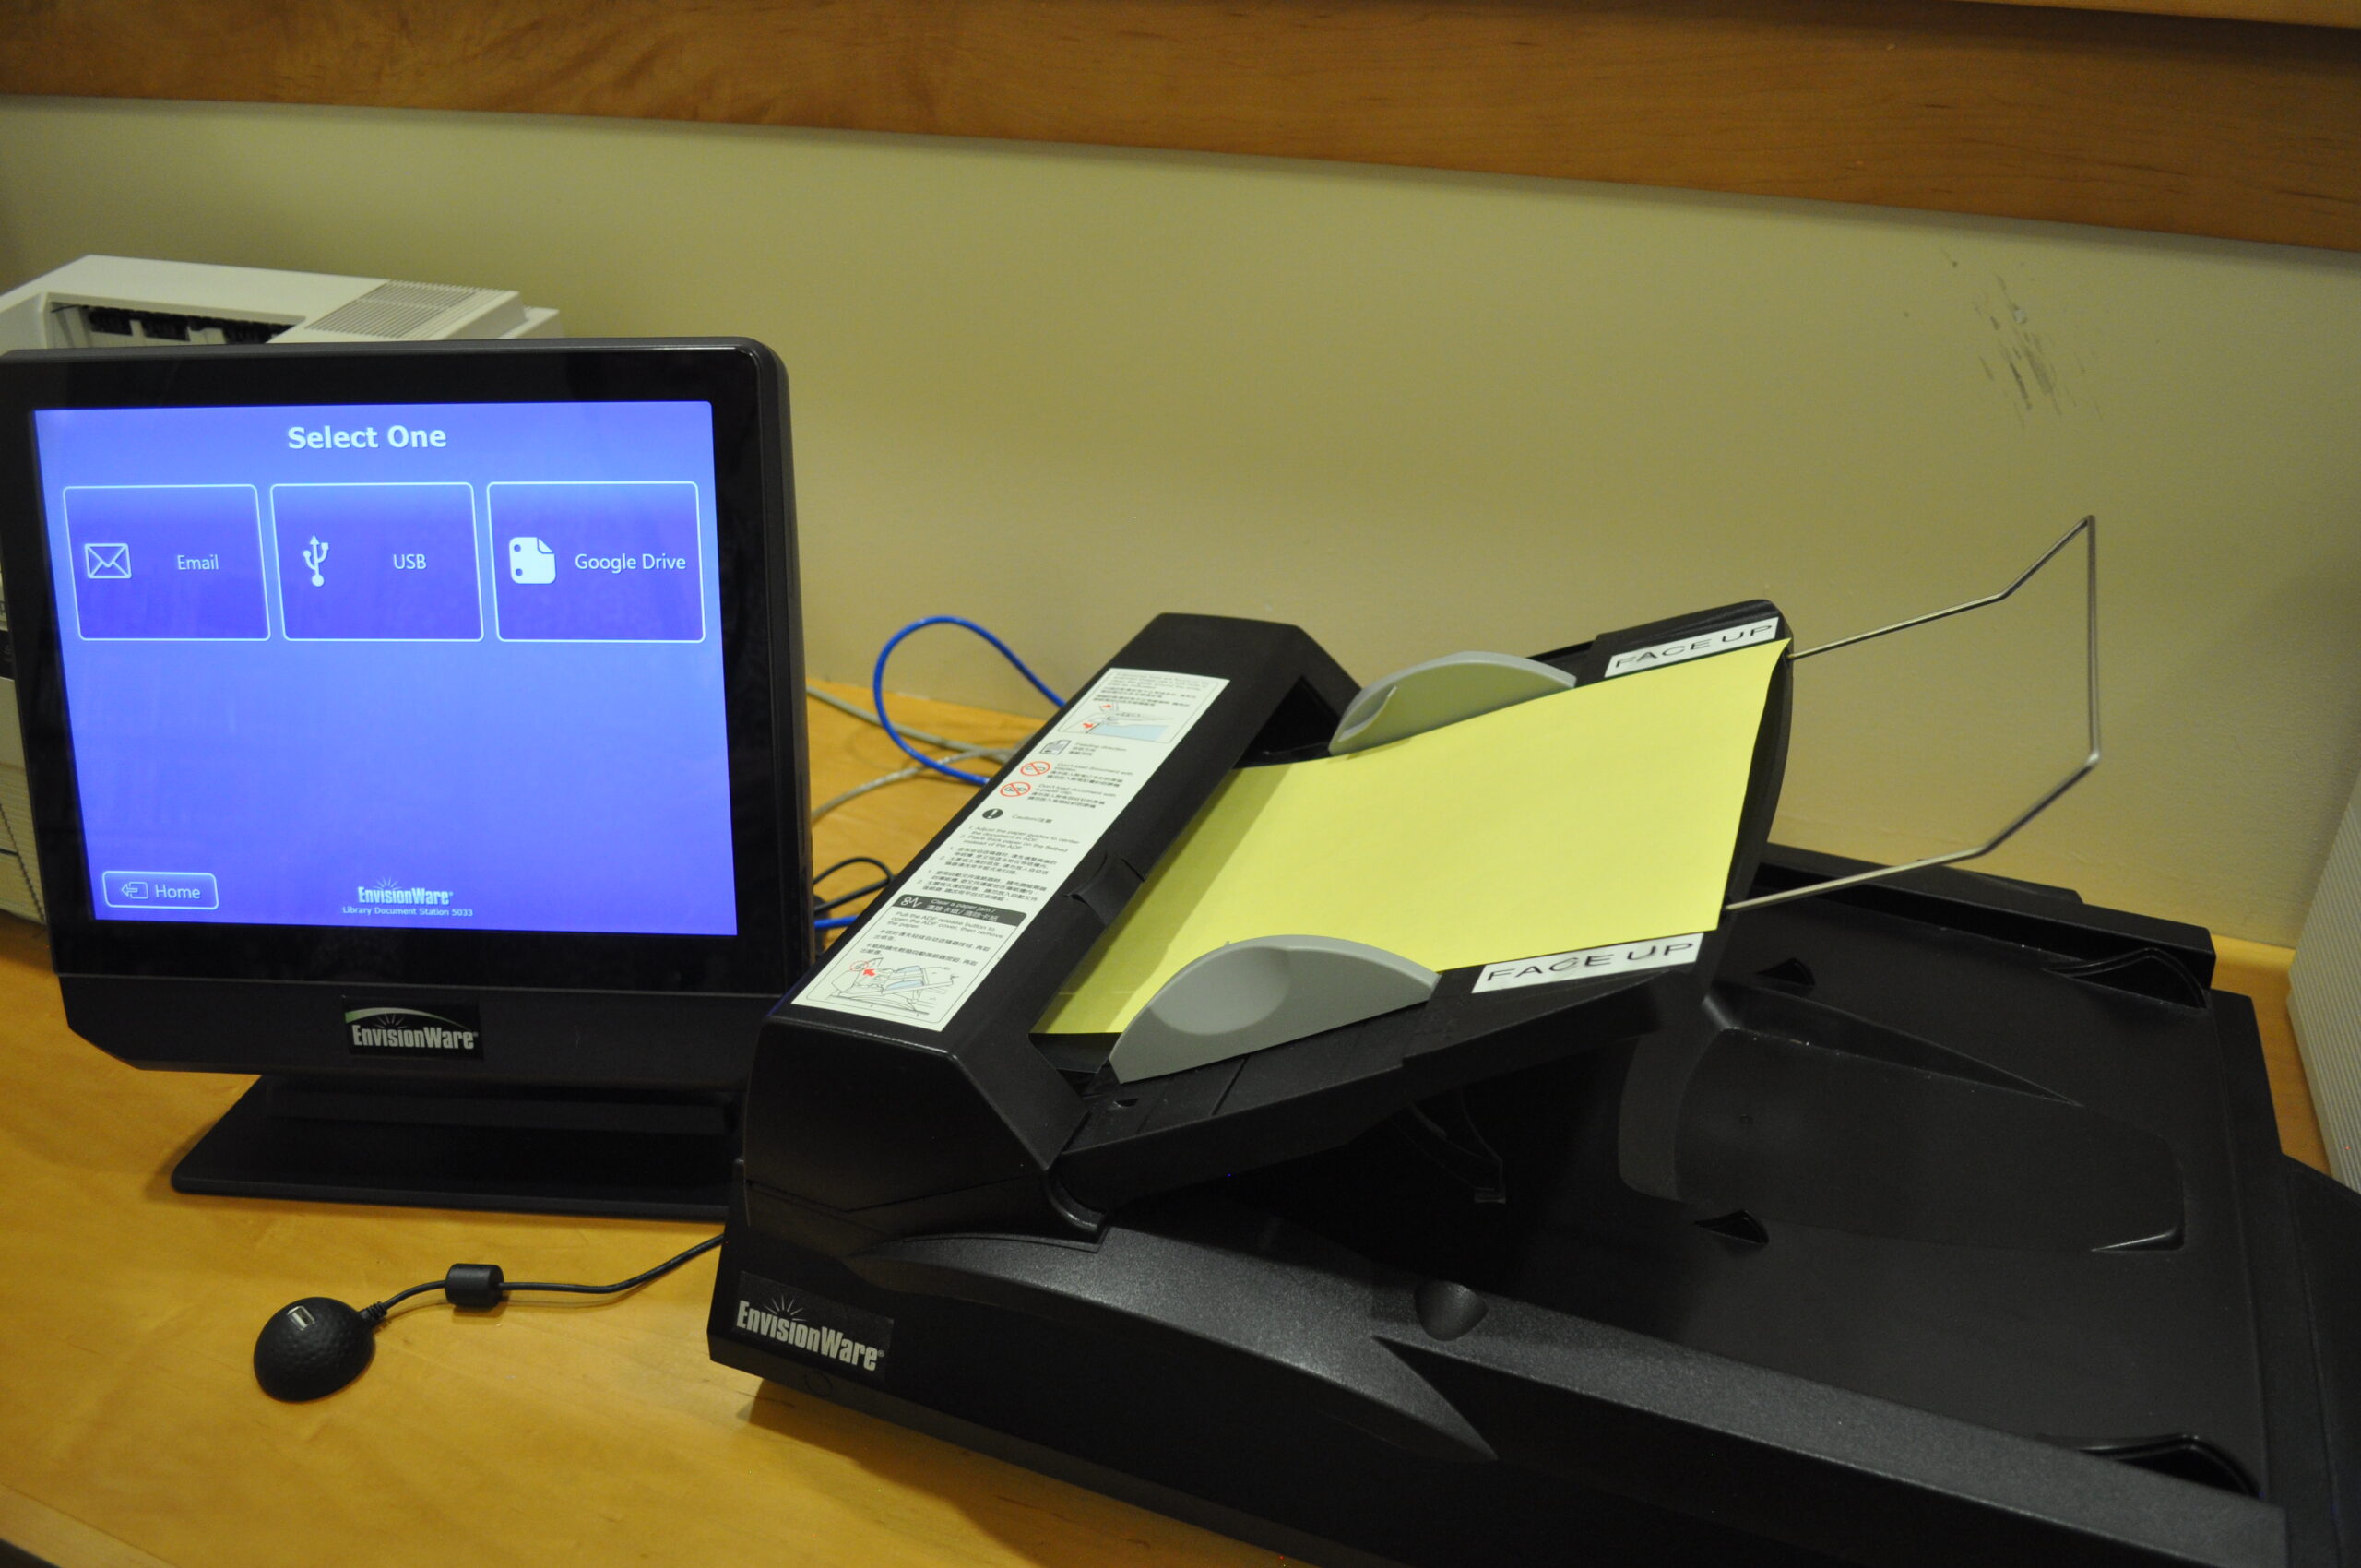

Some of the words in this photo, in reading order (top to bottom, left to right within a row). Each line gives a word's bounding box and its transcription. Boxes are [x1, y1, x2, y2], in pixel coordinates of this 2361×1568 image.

[288, 425, 379, 449] Select
[386, 424, 447, 448] One
[177, 554, 219, 571] Email
[393, 553, 427, 570] USB
[575, 553, 636, 574] Google
[642, 553, 686, 570] Drive
[1615, 638, 1713, 669] FACE
[1721, 624, 1773, 643] UP
[155, 884, 201, 899] Home
[358, 886, 450, 906] EnvisionWare
[343, 906, 373, 916] Library
[374, 907, 417, 916] Document
[419, 908, 450, 917] Station
[452, 909, 474, 917] 5033
[1487, 954, 1615, 982] FACE
[1626, 943, 1693, 961] UP
[351, 1024, 474, 1050] EnvisionWare
